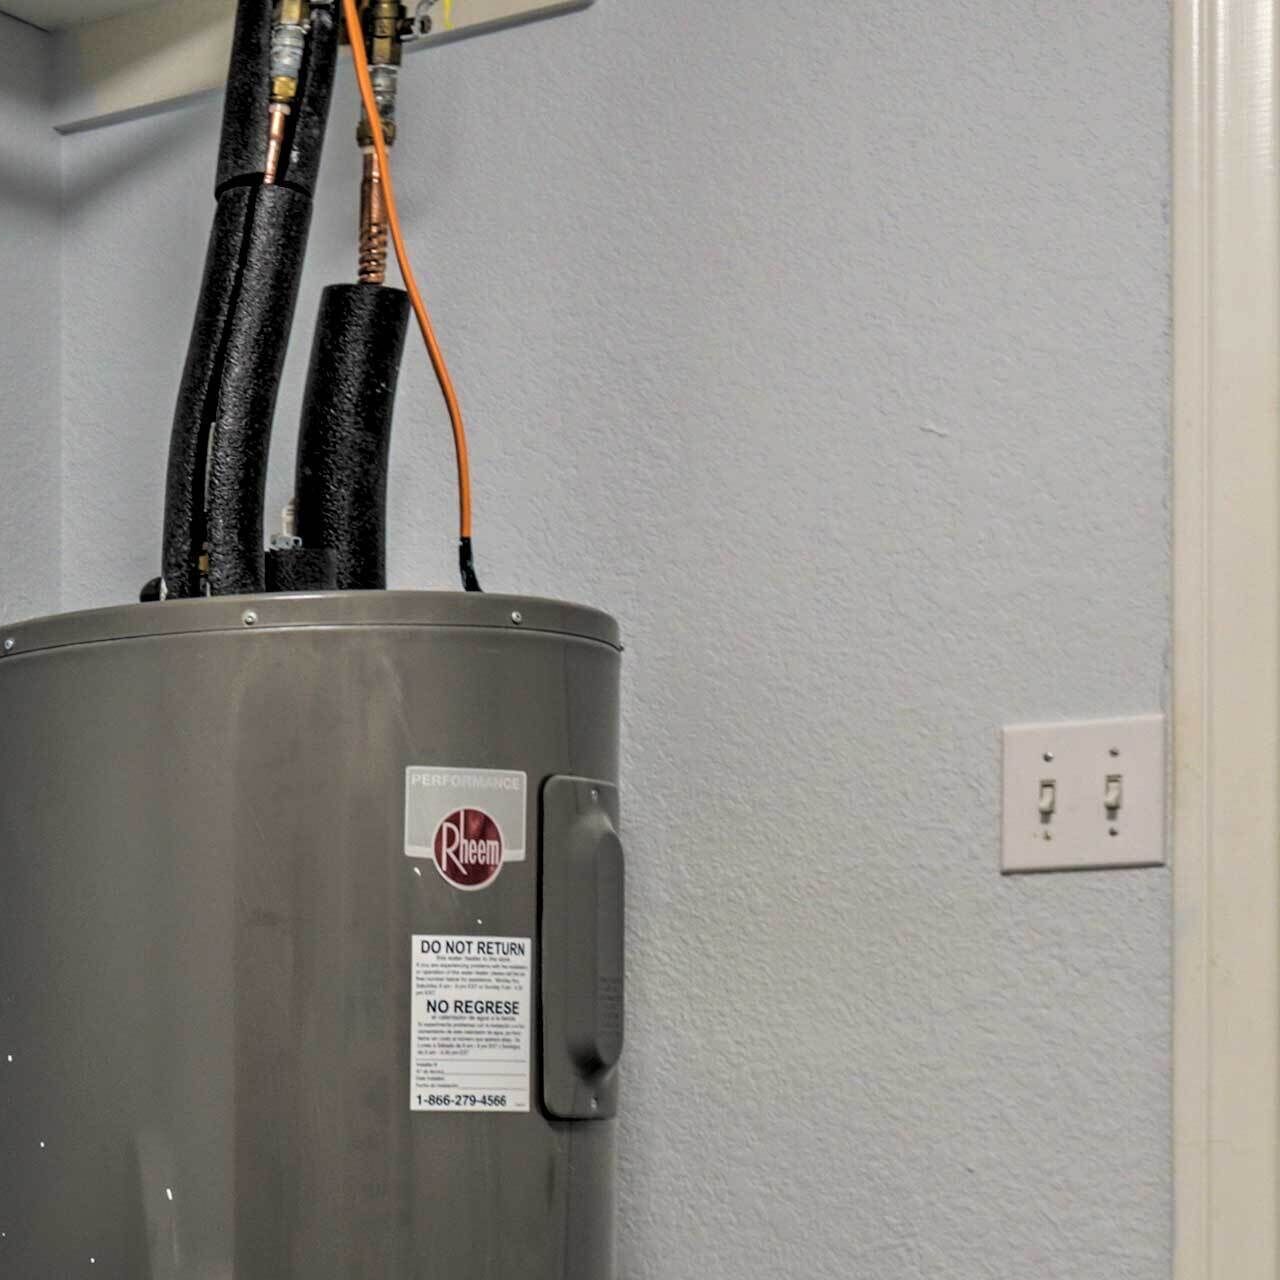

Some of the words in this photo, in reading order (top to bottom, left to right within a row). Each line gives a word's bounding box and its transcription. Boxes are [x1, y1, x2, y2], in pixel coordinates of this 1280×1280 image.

[411, 774, 521, 790] PERFORMANCE
[442, 809, 501, 876] Rheem
[421, 940, 441, 954] DO
[446, 940, 473, 954] NOT
[477, 941, 526, 956] RETURN
[426, 999, 449, 1014] NO
[454, 1000, 520, 1015] REGRESE
[416, 1093, 507, 1107] 1-866-279-4566
